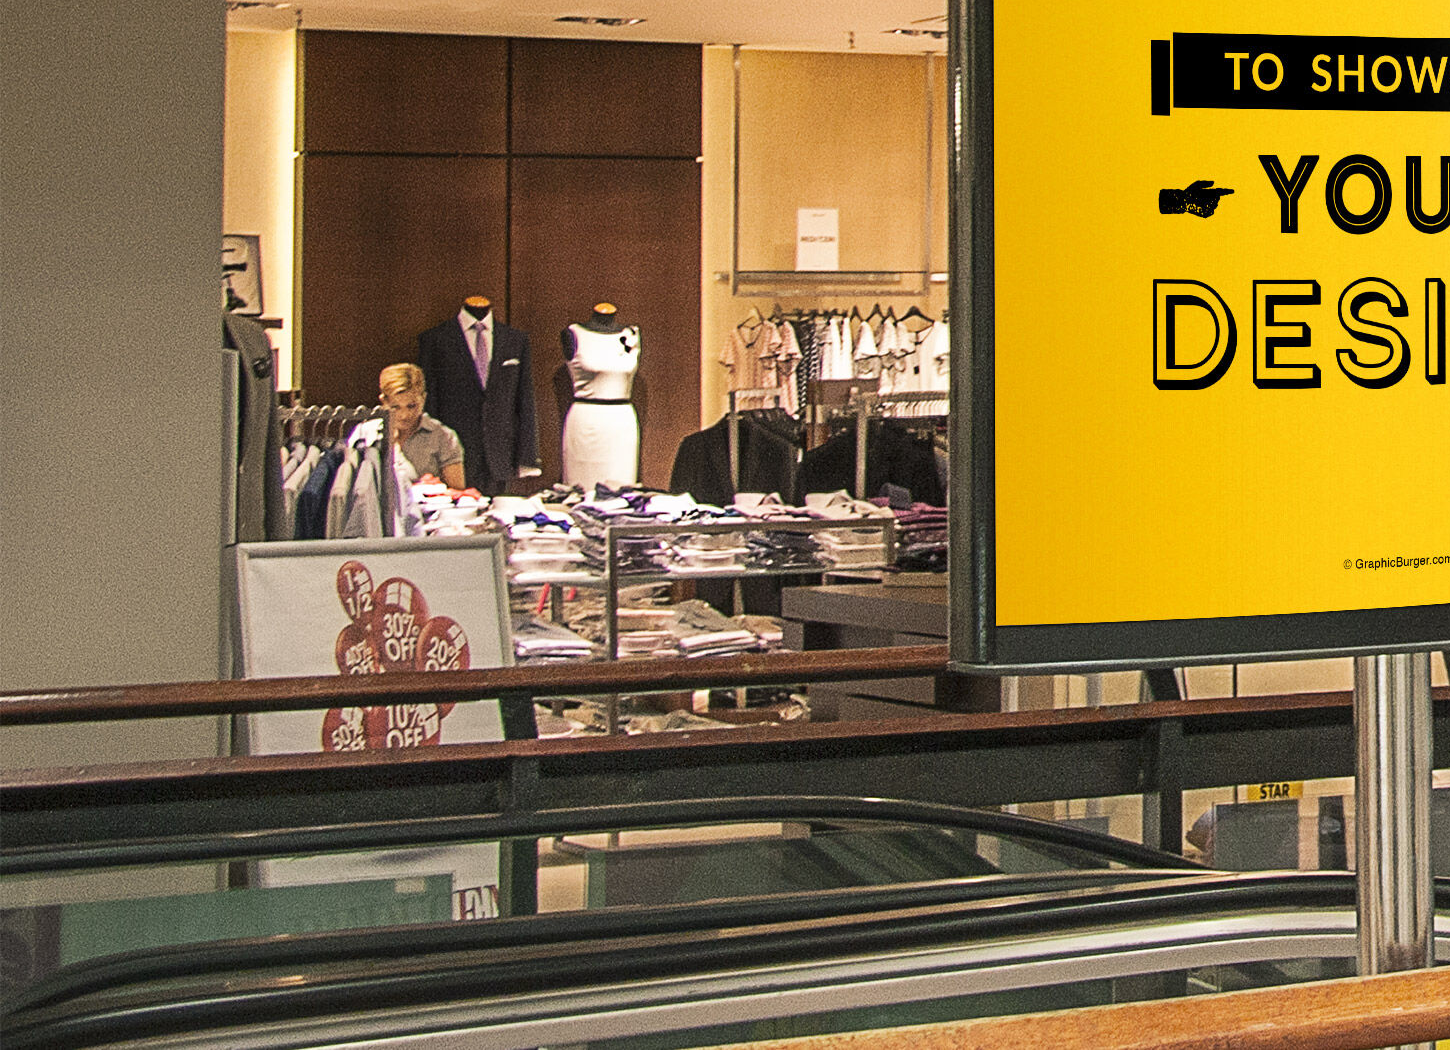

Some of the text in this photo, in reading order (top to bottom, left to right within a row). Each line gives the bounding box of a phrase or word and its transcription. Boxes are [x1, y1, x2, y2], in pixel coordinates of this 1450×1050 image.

[1223, 51, 1285, 92] TO
[346, 592, 374, 619] 1/2
[383, 612, 420, 639] 30%
[385, 638, 418, 662] OFF
[427, 636, 461, 671] 20%
[385, 704, 425, 728] 10%
[386, 727, 424, 749] OFF
[1260, 783, 1290, 799] STAR
